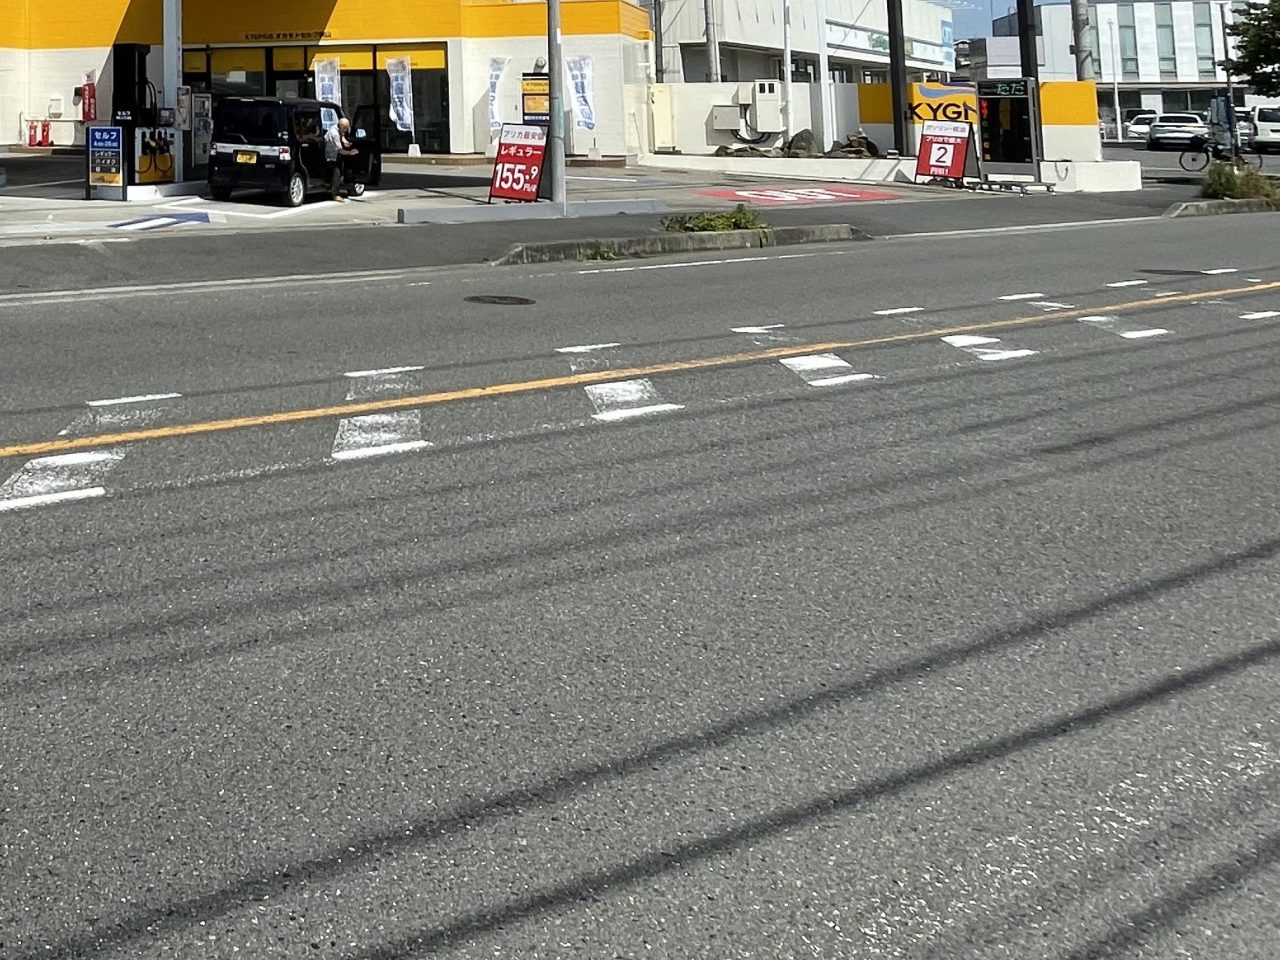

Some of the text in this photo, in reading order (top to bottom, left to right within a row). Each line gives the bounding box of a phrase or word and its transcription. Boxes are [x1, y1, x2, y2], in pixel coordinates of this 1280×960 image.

[94, 131, 117, 140] セルフ
[500, 145, 542, 157] レギュラー
[935, 147, 948, 164] 2
